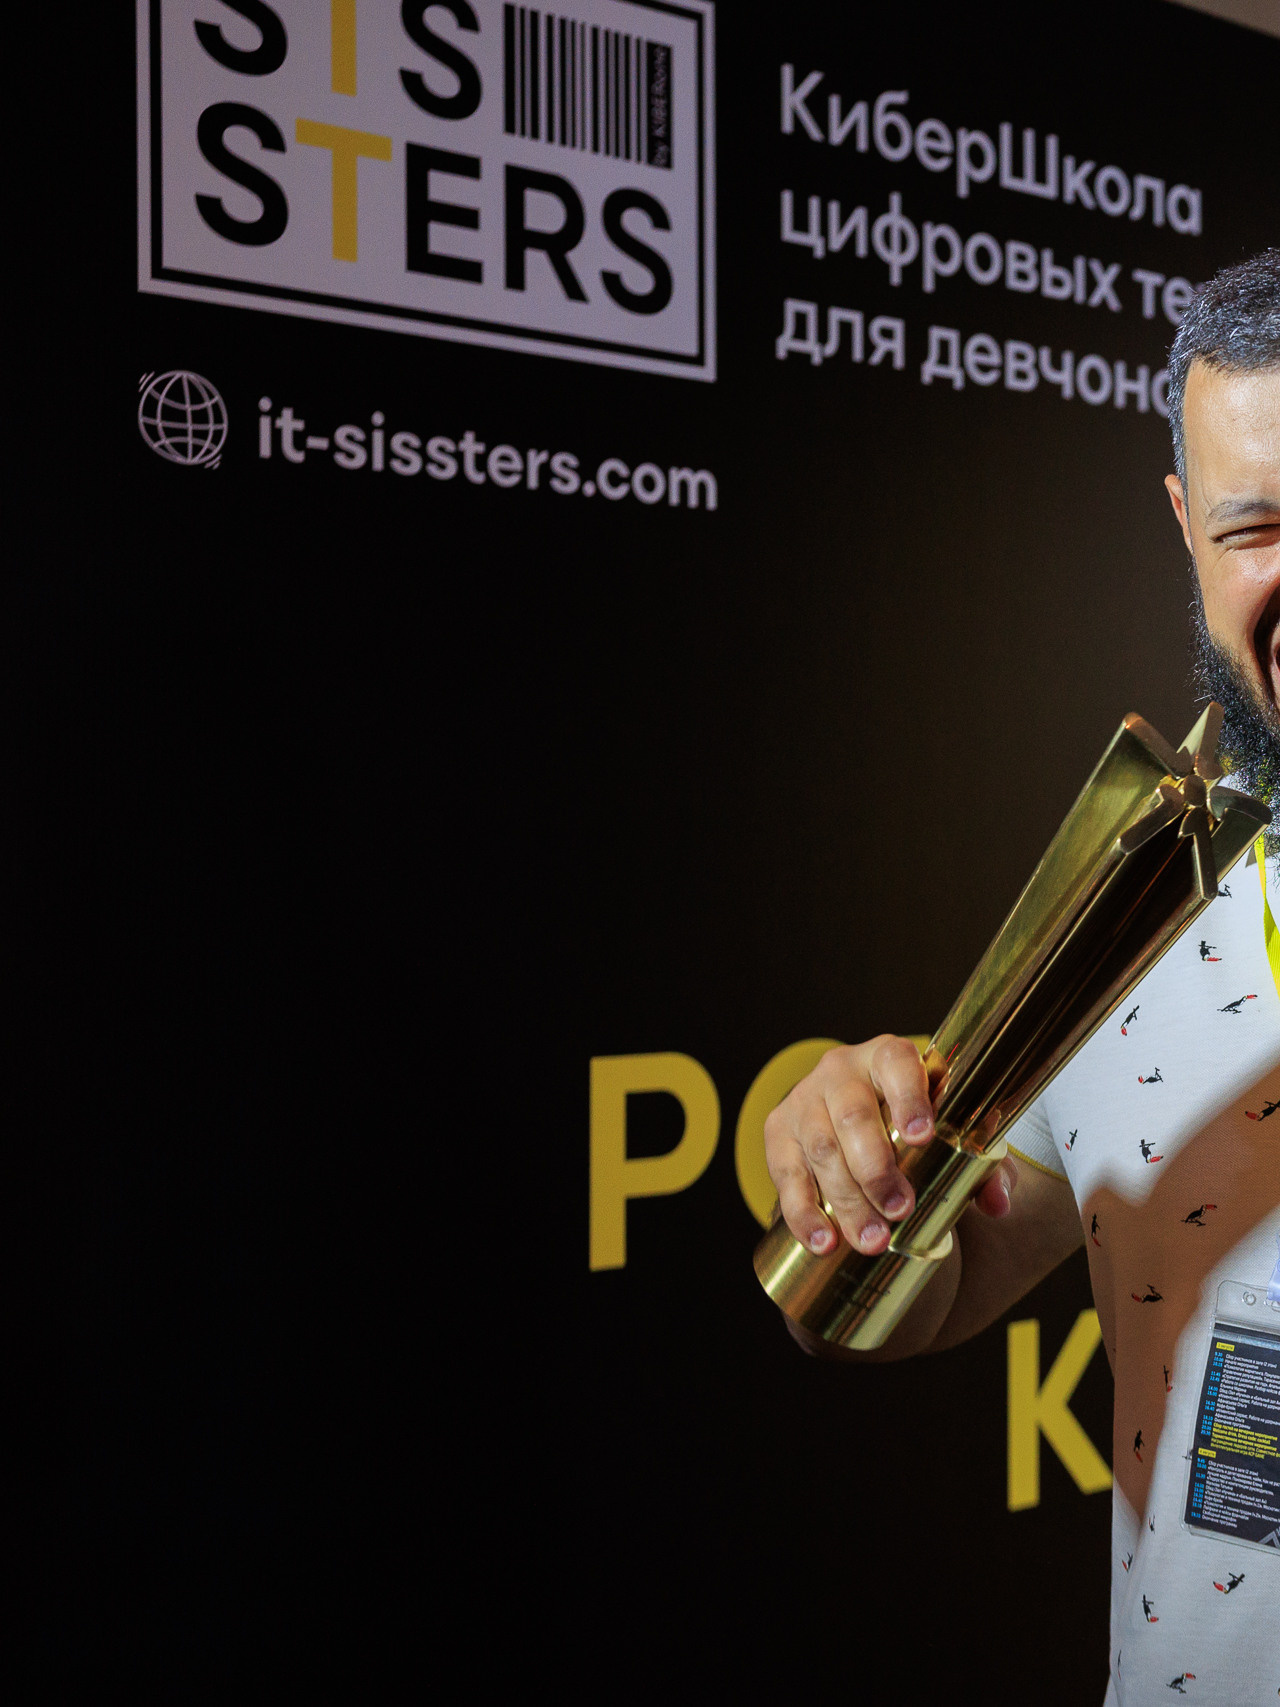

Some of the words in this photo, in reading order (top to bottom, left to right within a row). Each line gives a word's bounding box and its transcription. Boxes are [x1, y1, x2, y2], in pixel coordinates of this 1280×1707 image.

[194, 101, 674, 315] STERS
[780, 63, 1203, 236] КиберШкола
[780, 189, 1122, 312] цифровых
[1131, 268, 1206, 326] те
[776, 298, 905, 370] для
[258, 396, 718, 511] it-sissters.com
